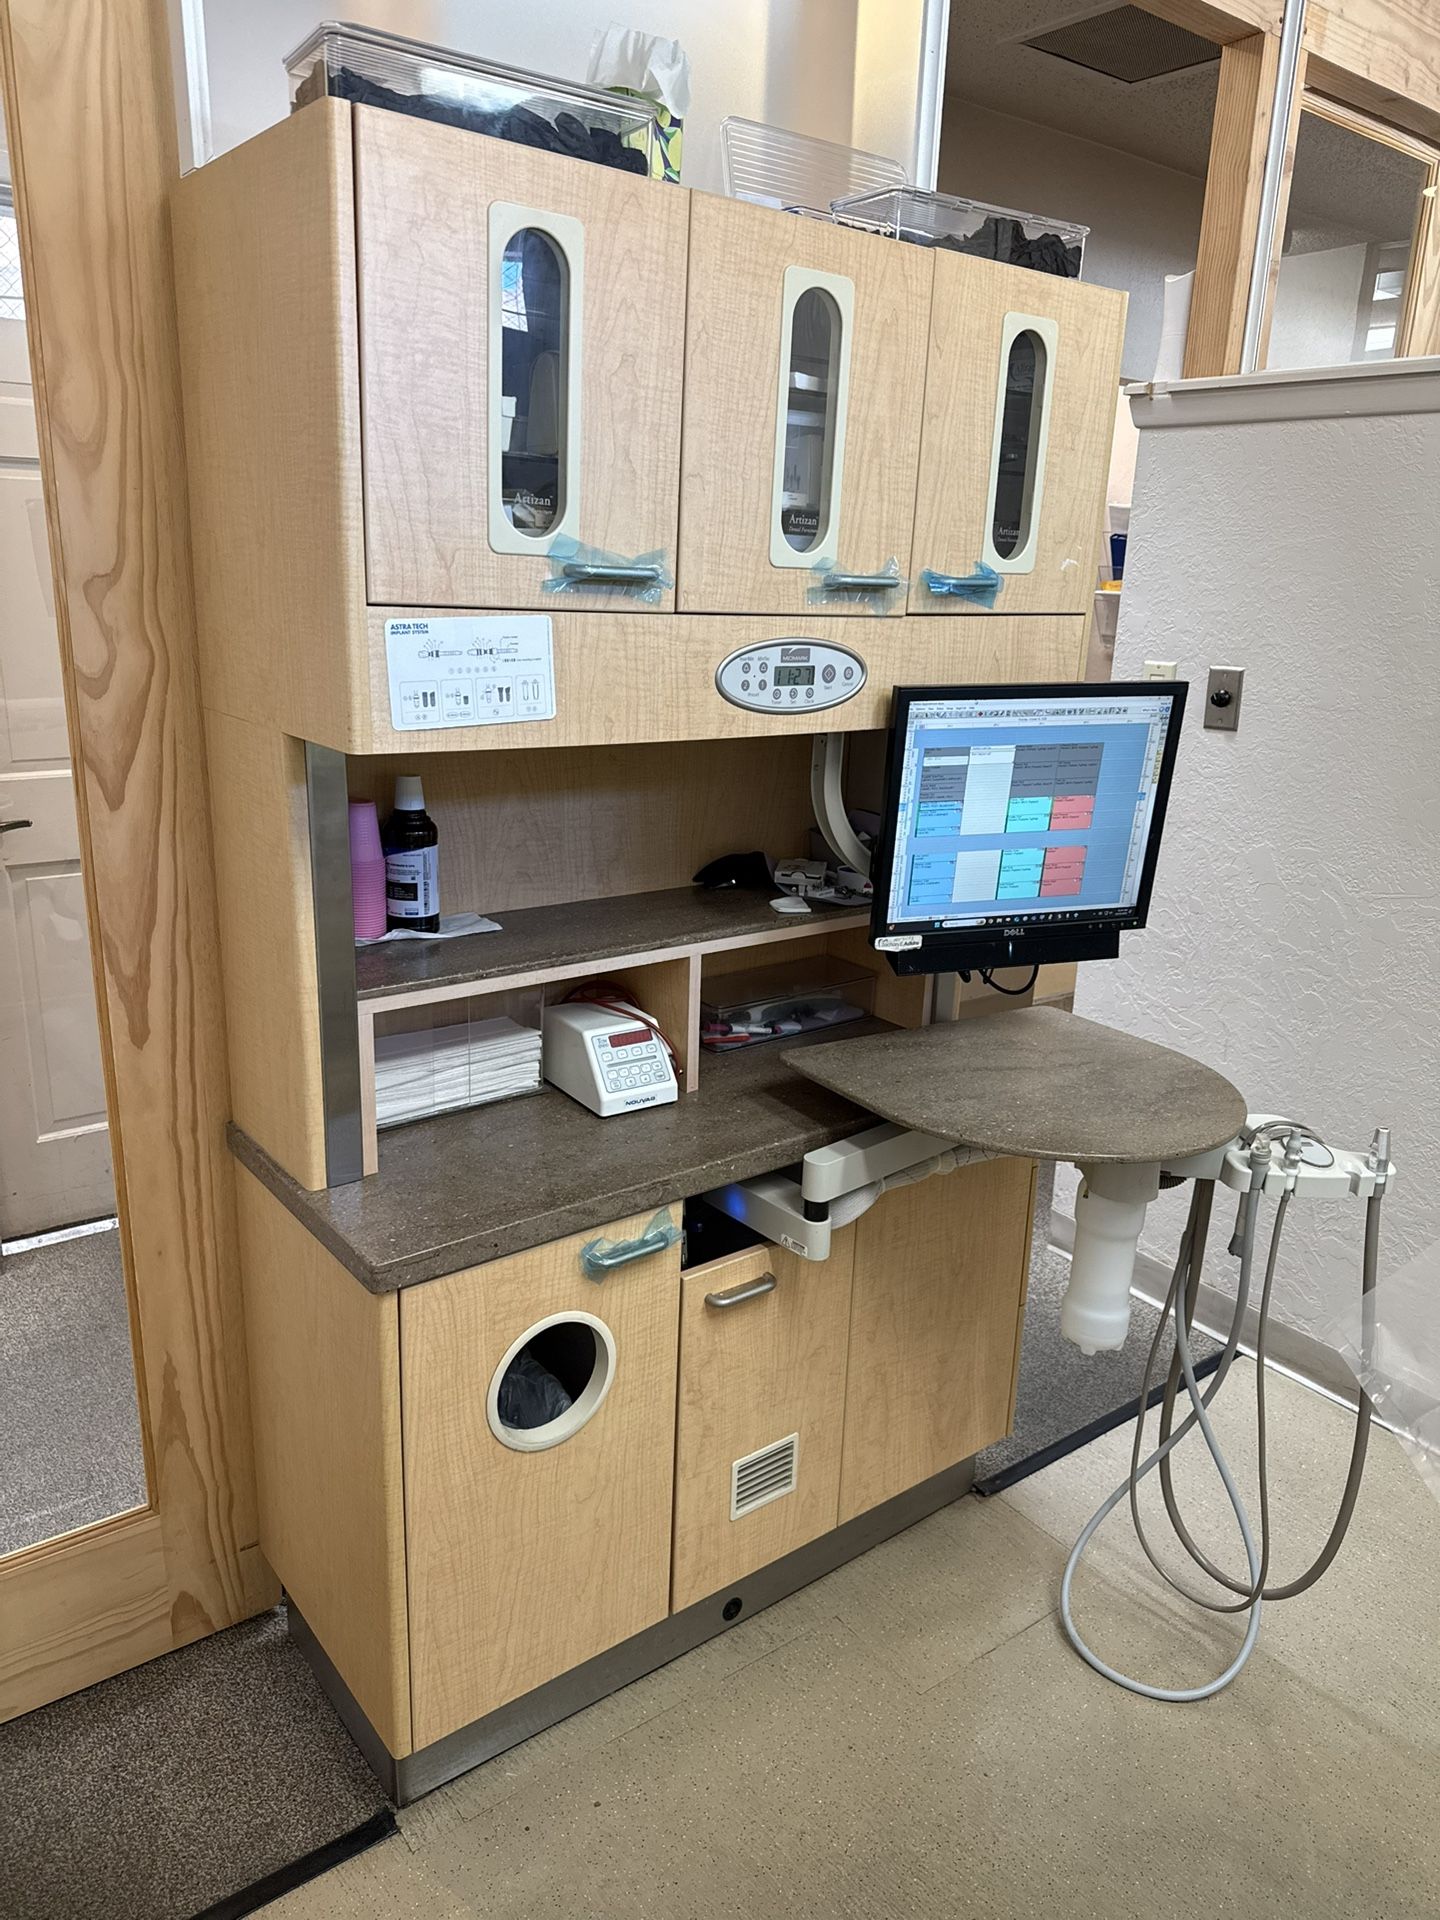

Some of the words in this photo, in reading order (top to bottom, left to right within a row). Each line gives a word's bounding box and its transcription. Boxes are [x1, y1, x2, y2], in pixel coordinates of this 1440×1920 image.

[514, 492, 551, 506] Artizan
[789, 513, 817, 525] Artizan
[412, 622, 429, 630] TECH
[776, 668, 812, 685] 11:27
[1003, 928, 1025, 937] DELL
[625, 1096, 656, 1106] NOUVAG
